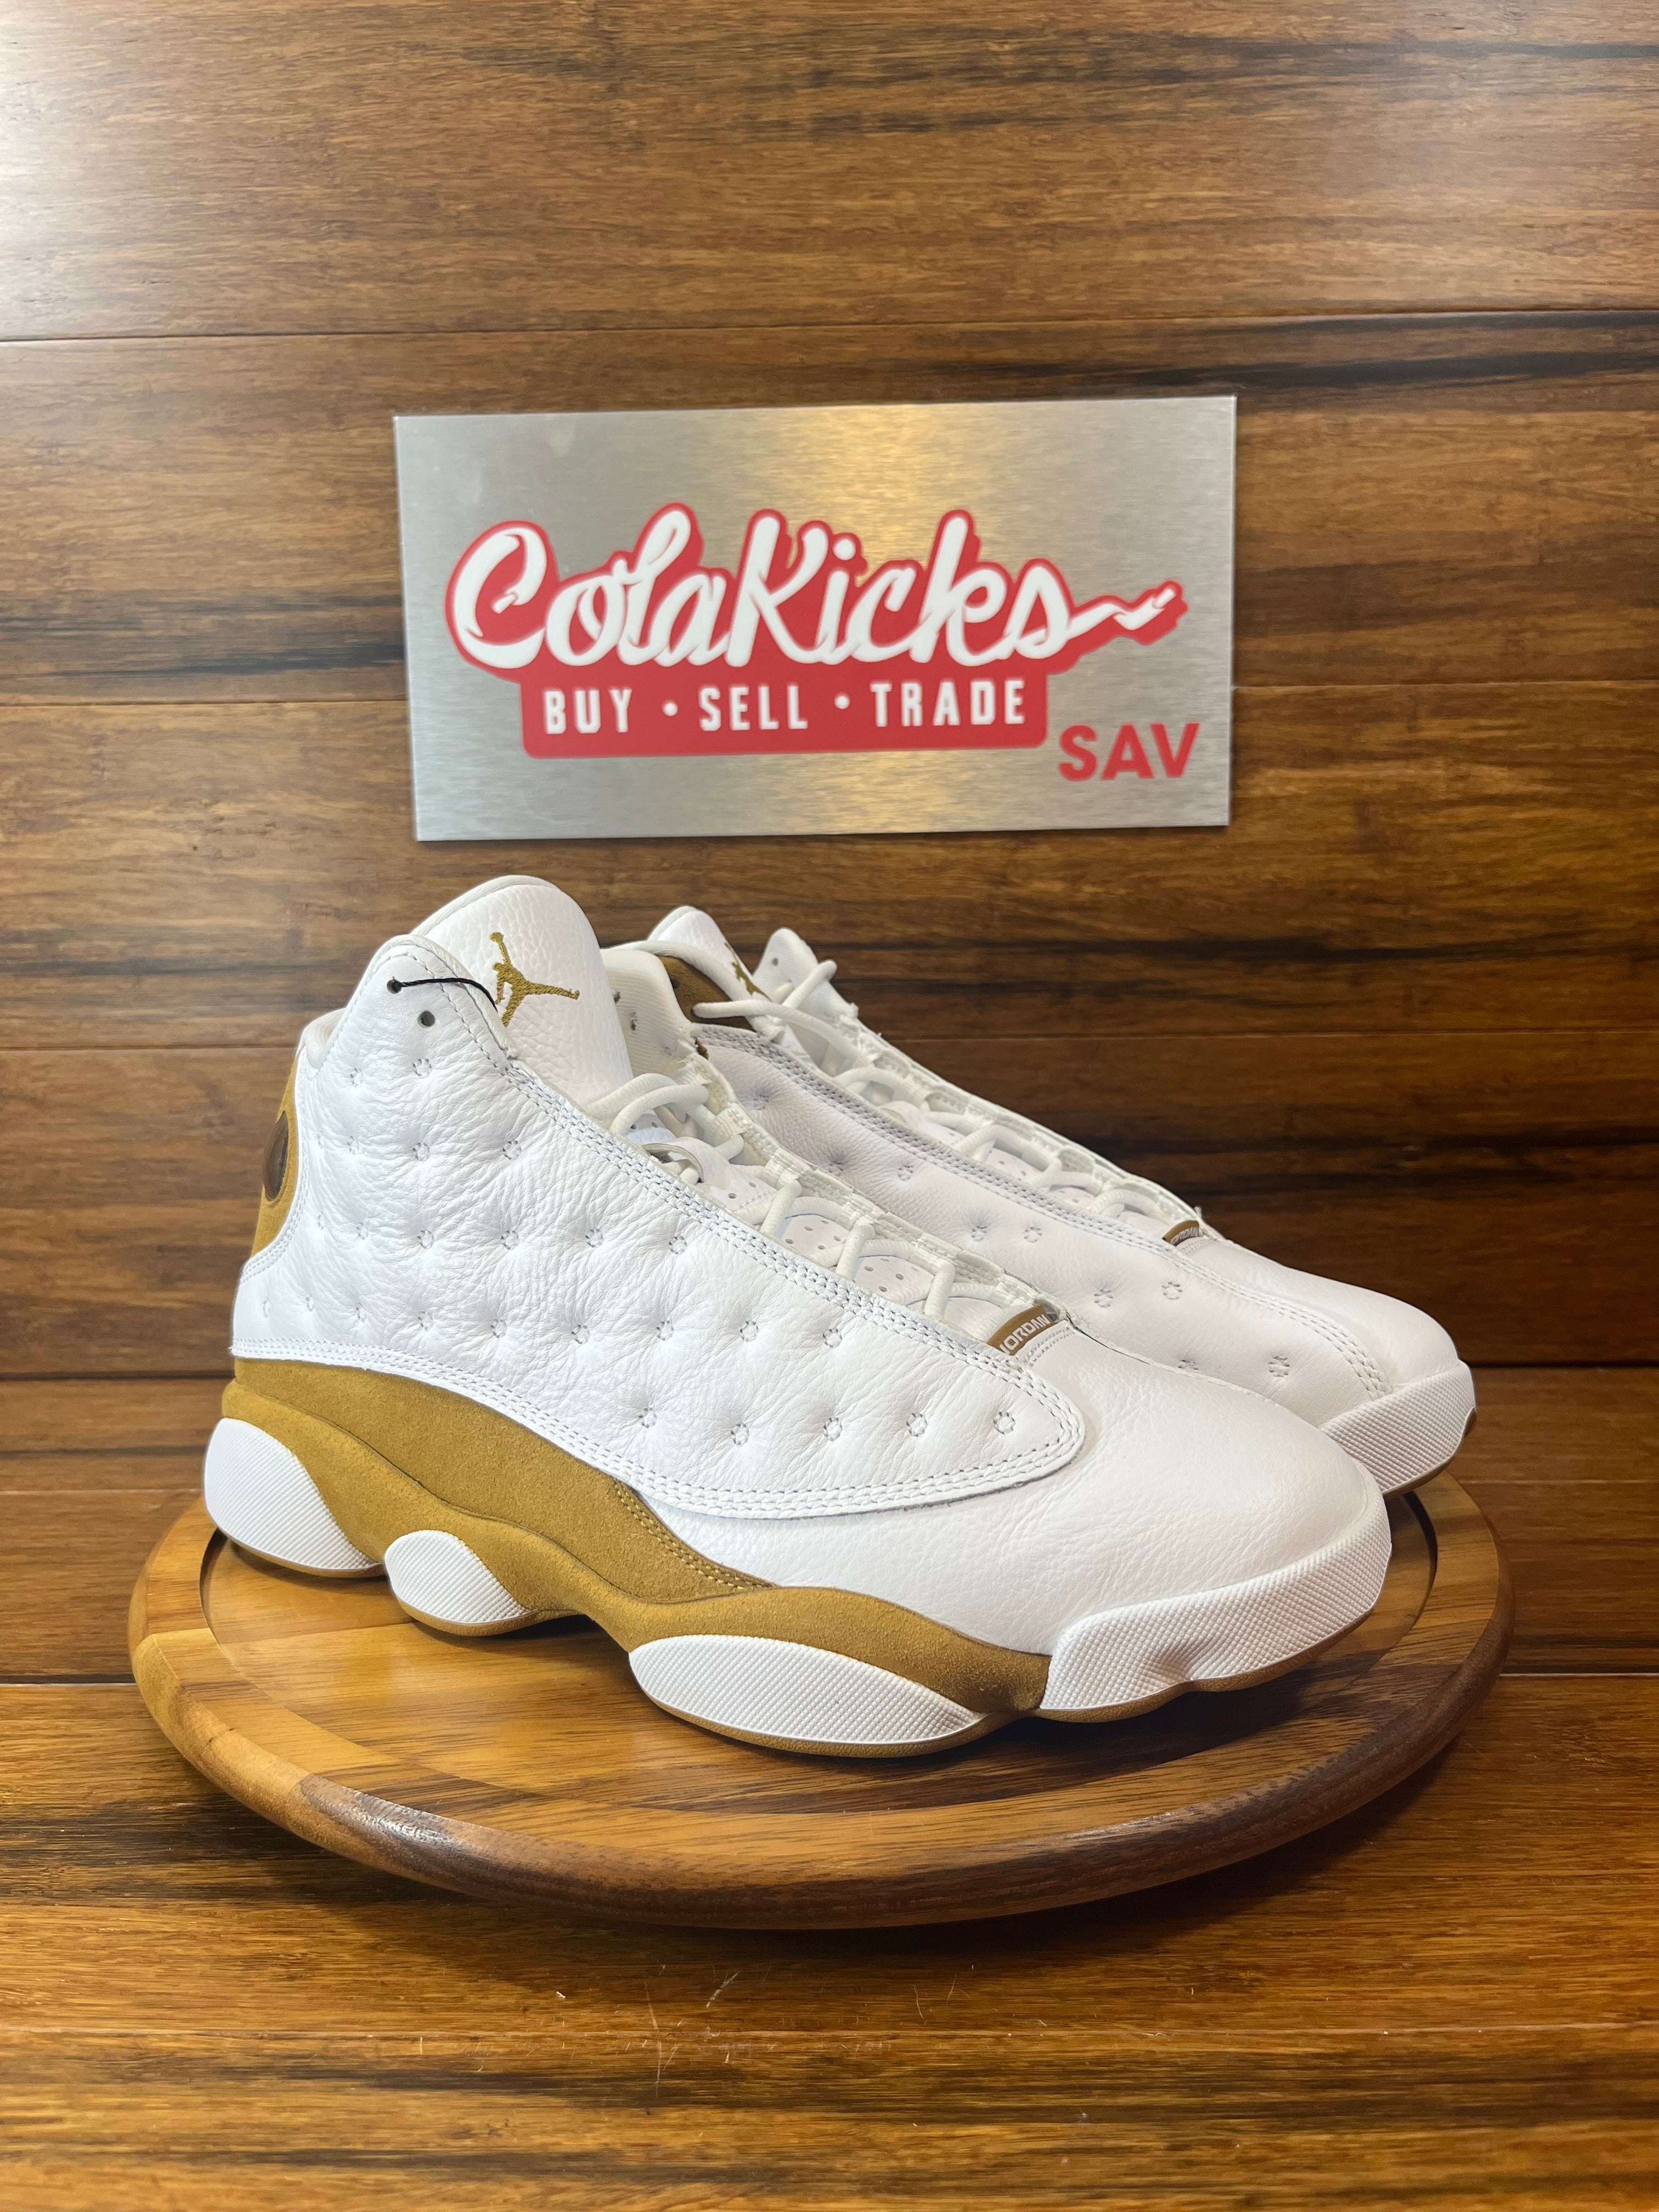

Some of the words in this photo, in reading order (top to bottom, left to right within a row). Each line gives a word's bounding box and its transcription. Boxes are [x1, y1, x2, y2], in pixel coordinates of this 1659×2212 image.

[543, 688, 632, 735] BUY
[699, 685, 808, 731] SELL
[870, 679, 1025, 727] TRADE
[1059, 723, 1199, 781] SAV
